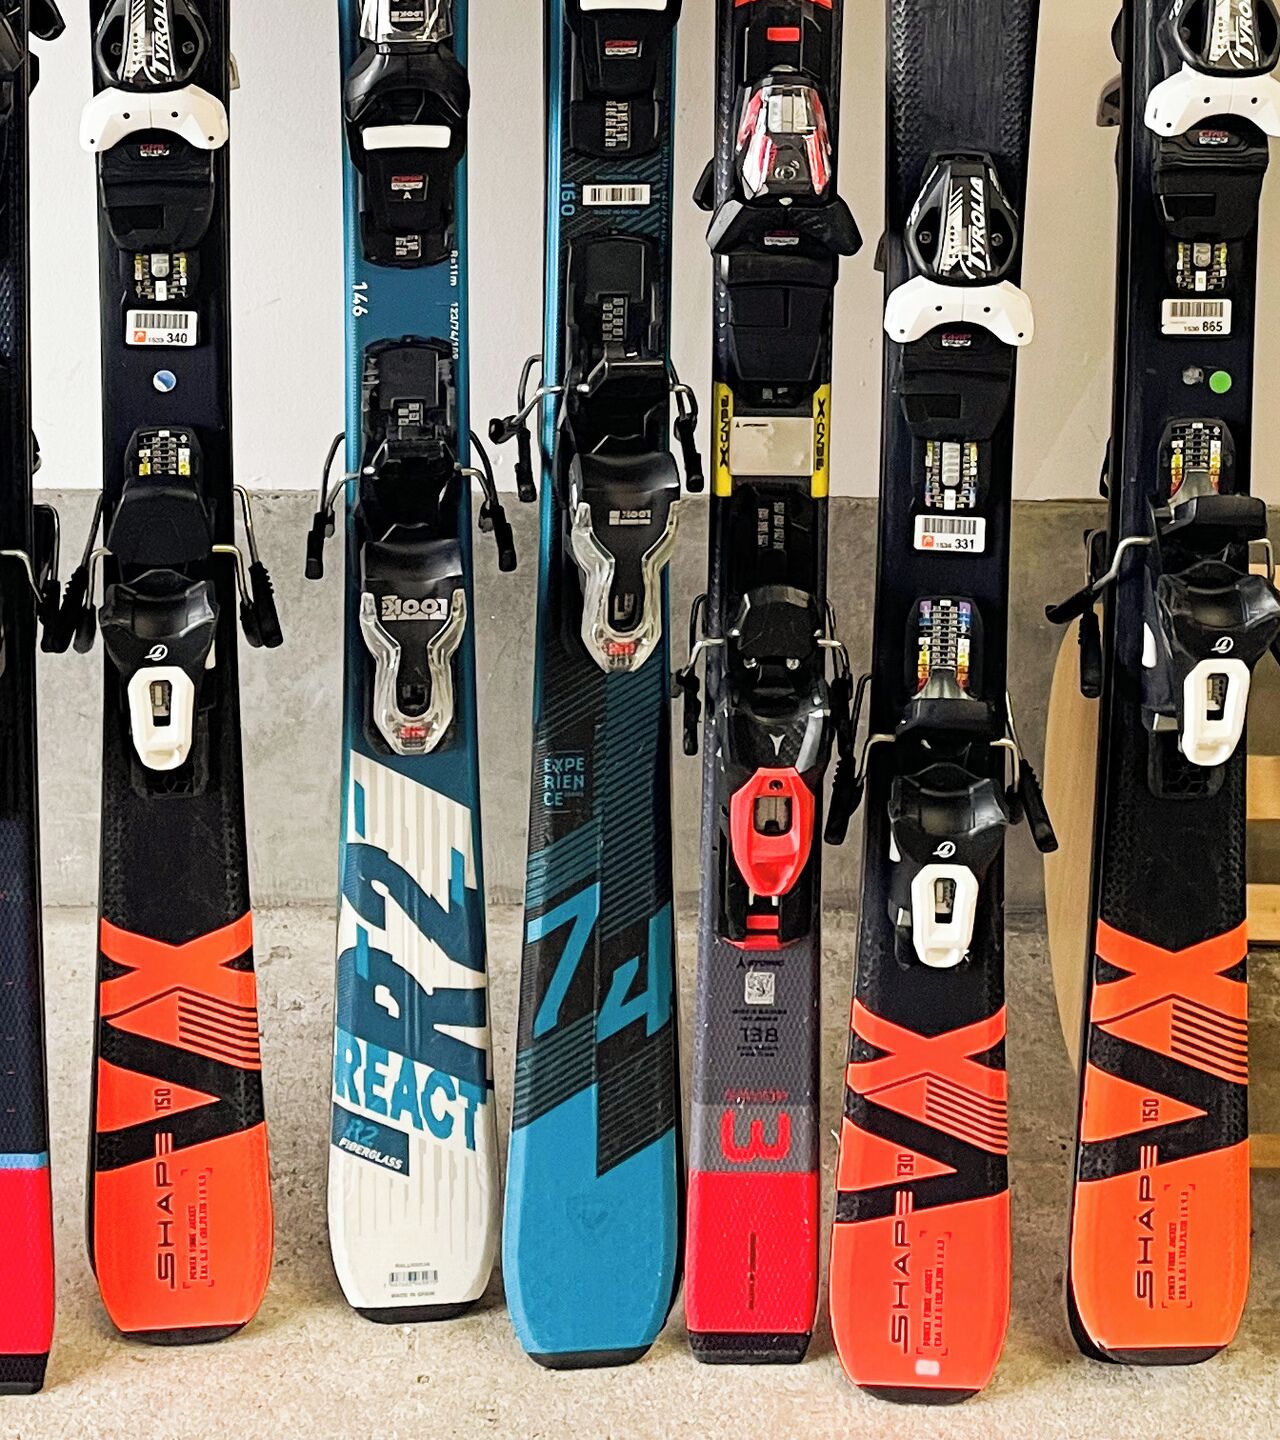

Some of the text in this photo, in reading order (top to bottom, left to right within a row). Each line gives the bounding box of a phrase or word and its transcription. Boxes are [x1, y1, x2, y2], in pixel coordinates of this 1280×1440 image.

[561, 182, 576, 217] 160
[967, 176, 992, 272] TYROLIA
[352, 281, 368, 318] 146
[166, 332, 189, 345] 340
[1202, 320, 1224, 332] 865
[719, 394, 730, 469] BEND-X
[815, 396, 826, 472] BEND-X
[955, 538, 975, 550] 331
[543, 757, 585, 772] EXPE
[543, 774, 585, 791] RIEN
[543, 791, 564, 807] CE
[525, 881, 673, 1041] 74
[154, 1087, 172, 1112] 150
[335, 1026, 486, 1152] REACT
[1142, 1099, 1160, 1123] 150
[344, 1118, 381, 1143] R2
[720, 1108, 791, 1163] 3
[338, 1137, 404, 1171] FIBERGLASS
[897, 1154, 915, 1177] 130
[154, 1131, 175, 1290] SHAPE
[1136, 1145, 1158, 1309] SHAPE
[891, 1190, 914, 1354] SHAPE
